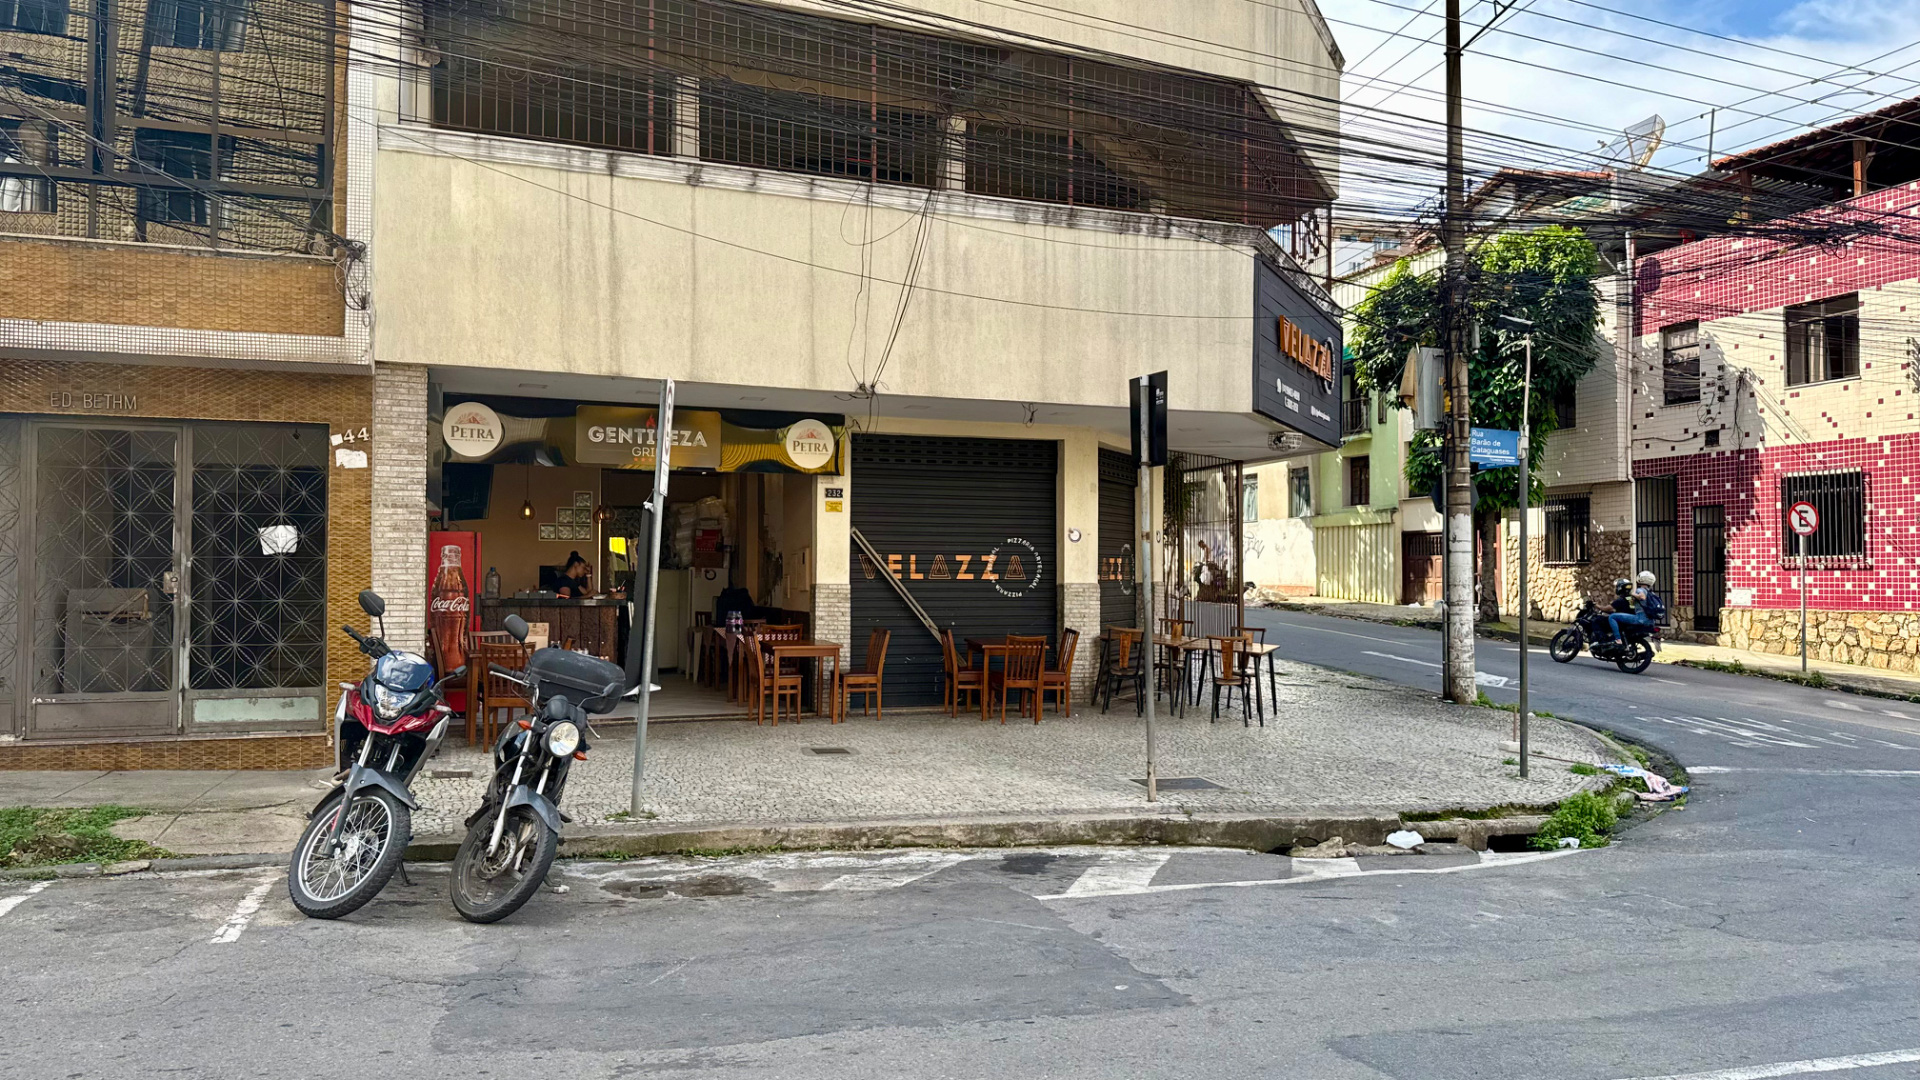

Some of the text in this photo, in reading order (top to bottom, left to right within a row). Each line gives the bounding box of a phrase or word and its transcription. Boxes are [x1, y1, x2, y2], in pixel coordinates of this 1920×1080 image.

[50, 391, 137, 410] ED. BETHM
[343, 426, 370, 443] 44
[450, 425, 495, 439] PETRA
[588, 425, 708, 448] GENTIEZA
[792, 441, 829, 453] PETRA
[1471, 438, 1491, 446] Barão
[1471, 446, 1510, 455] Cataguases
[827, 489, 841, 497] 232
[1799, 509, 1809, 528] E
